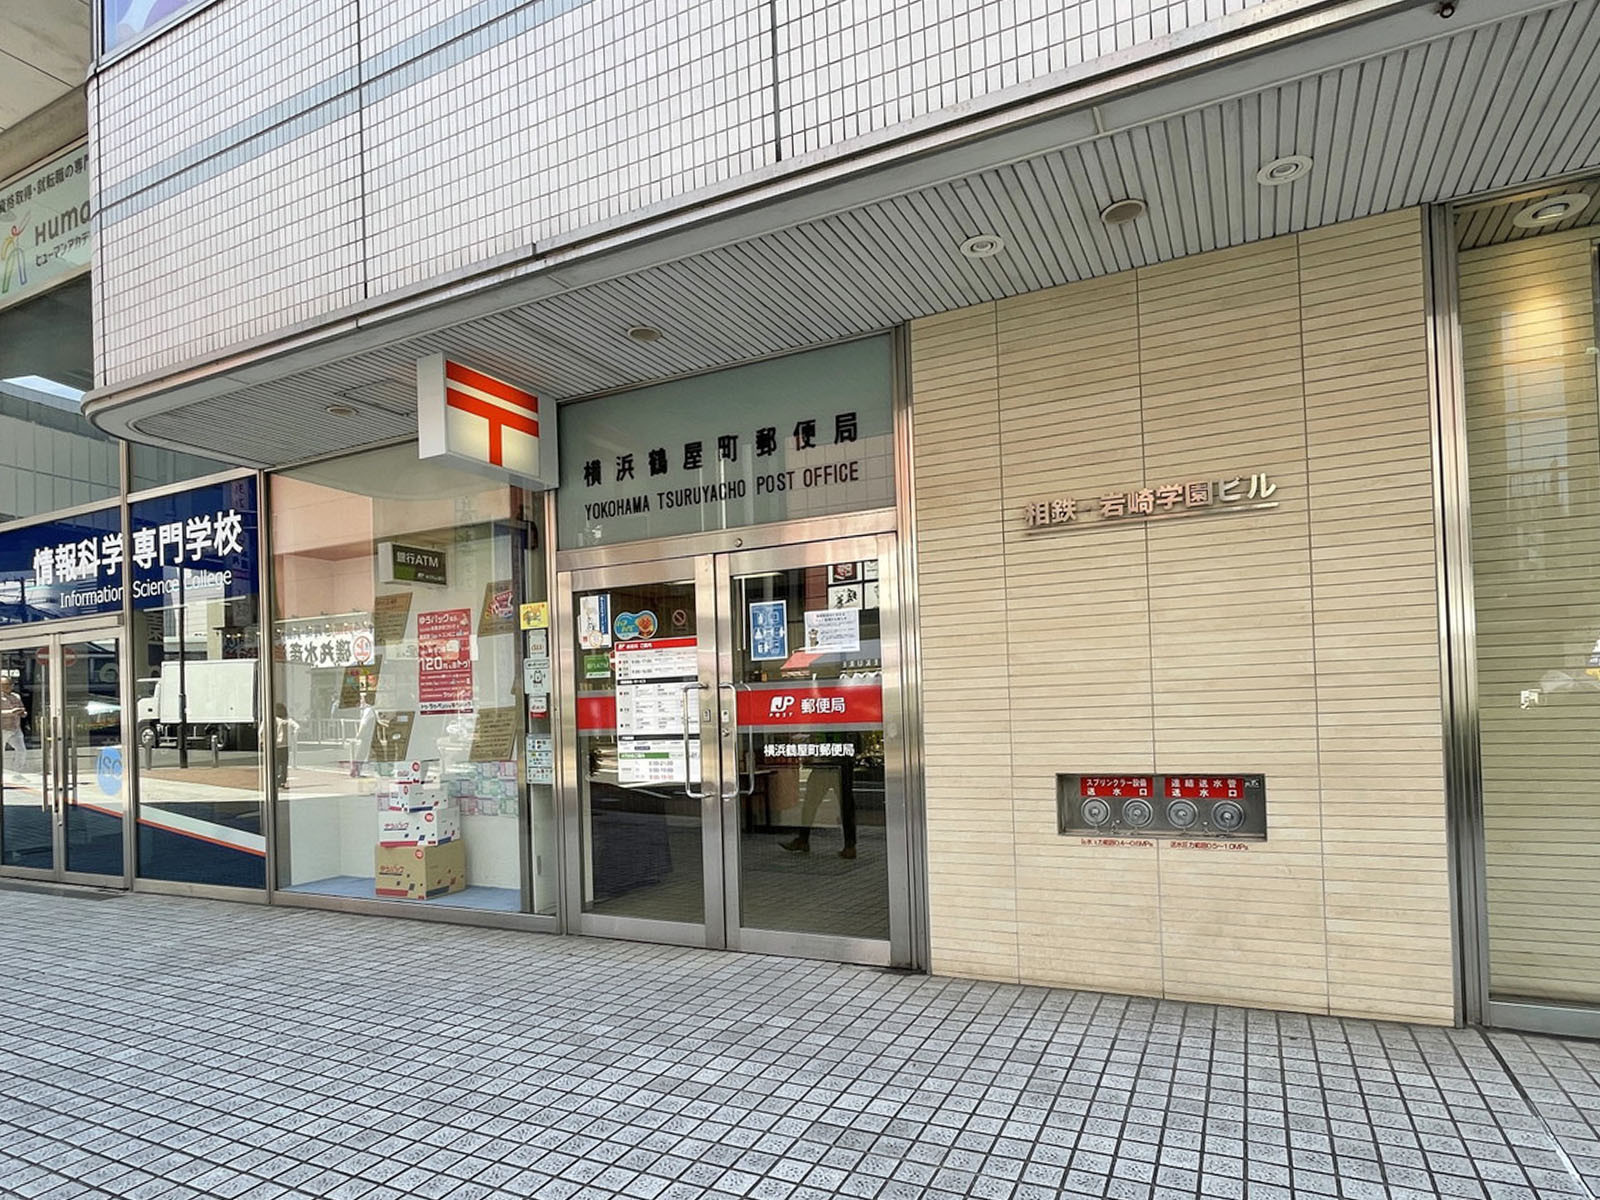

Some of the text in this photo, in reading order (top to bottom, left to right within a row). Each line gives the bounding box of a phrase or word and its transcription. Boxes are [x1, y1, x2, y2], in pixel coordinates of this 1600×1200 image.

[583, 412, 857, 487] 横浜鶴屋町郵便局
[584, 461, 859, 521] YOKOHAMA TSURUYACHO POST OFFICE
[60, 567, 232, 608] Information Science College
[801, 697, 846, 714] 郵便局
[763, 743, 856, 758] 横浜鶴屋町郵便局
[1087, 787, 1148, 796] 送水口
[1171, 788, 1238, 798] 送水口
